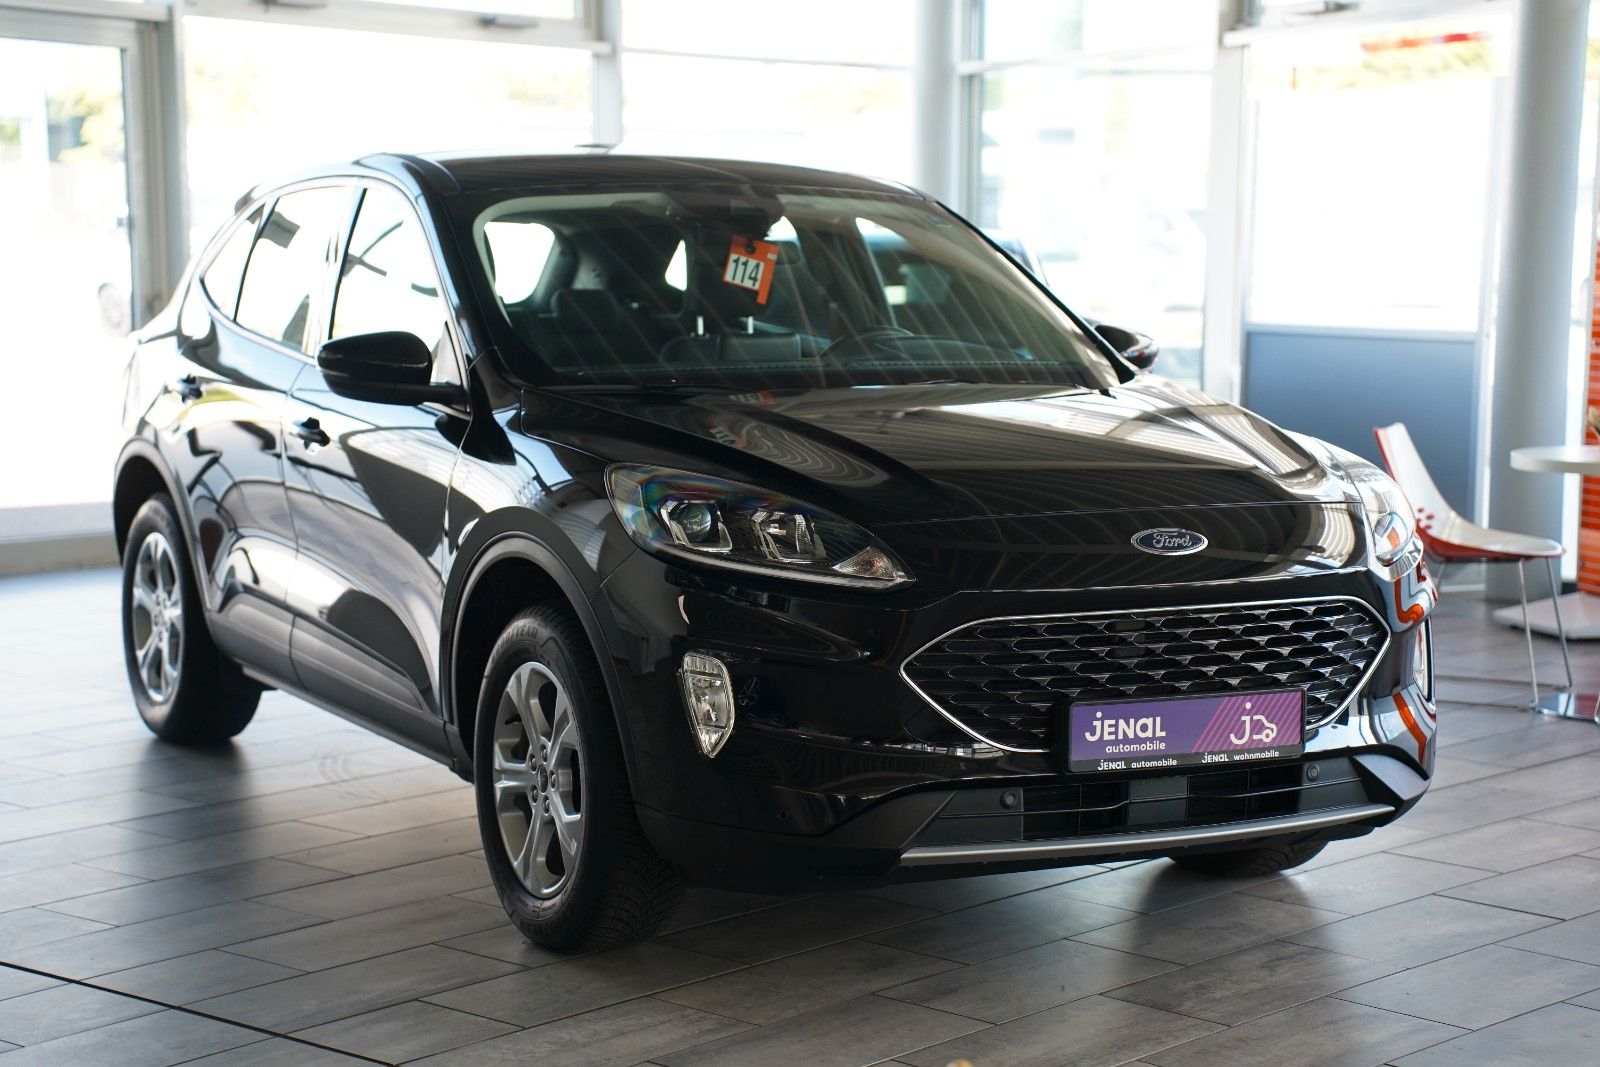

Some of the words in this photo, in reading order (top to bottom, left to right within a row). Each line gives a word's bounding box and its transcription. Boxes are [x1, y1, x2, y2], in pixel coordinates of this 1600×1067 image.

[732, 256, 761, 287] 114
[1152, 531, 1193, 548] Ford
[1106, 741, 1166, 753] automobile
[1234, 750, 1280, 760] wohnmobile
[1131, 759, 1177, 768] automobile
